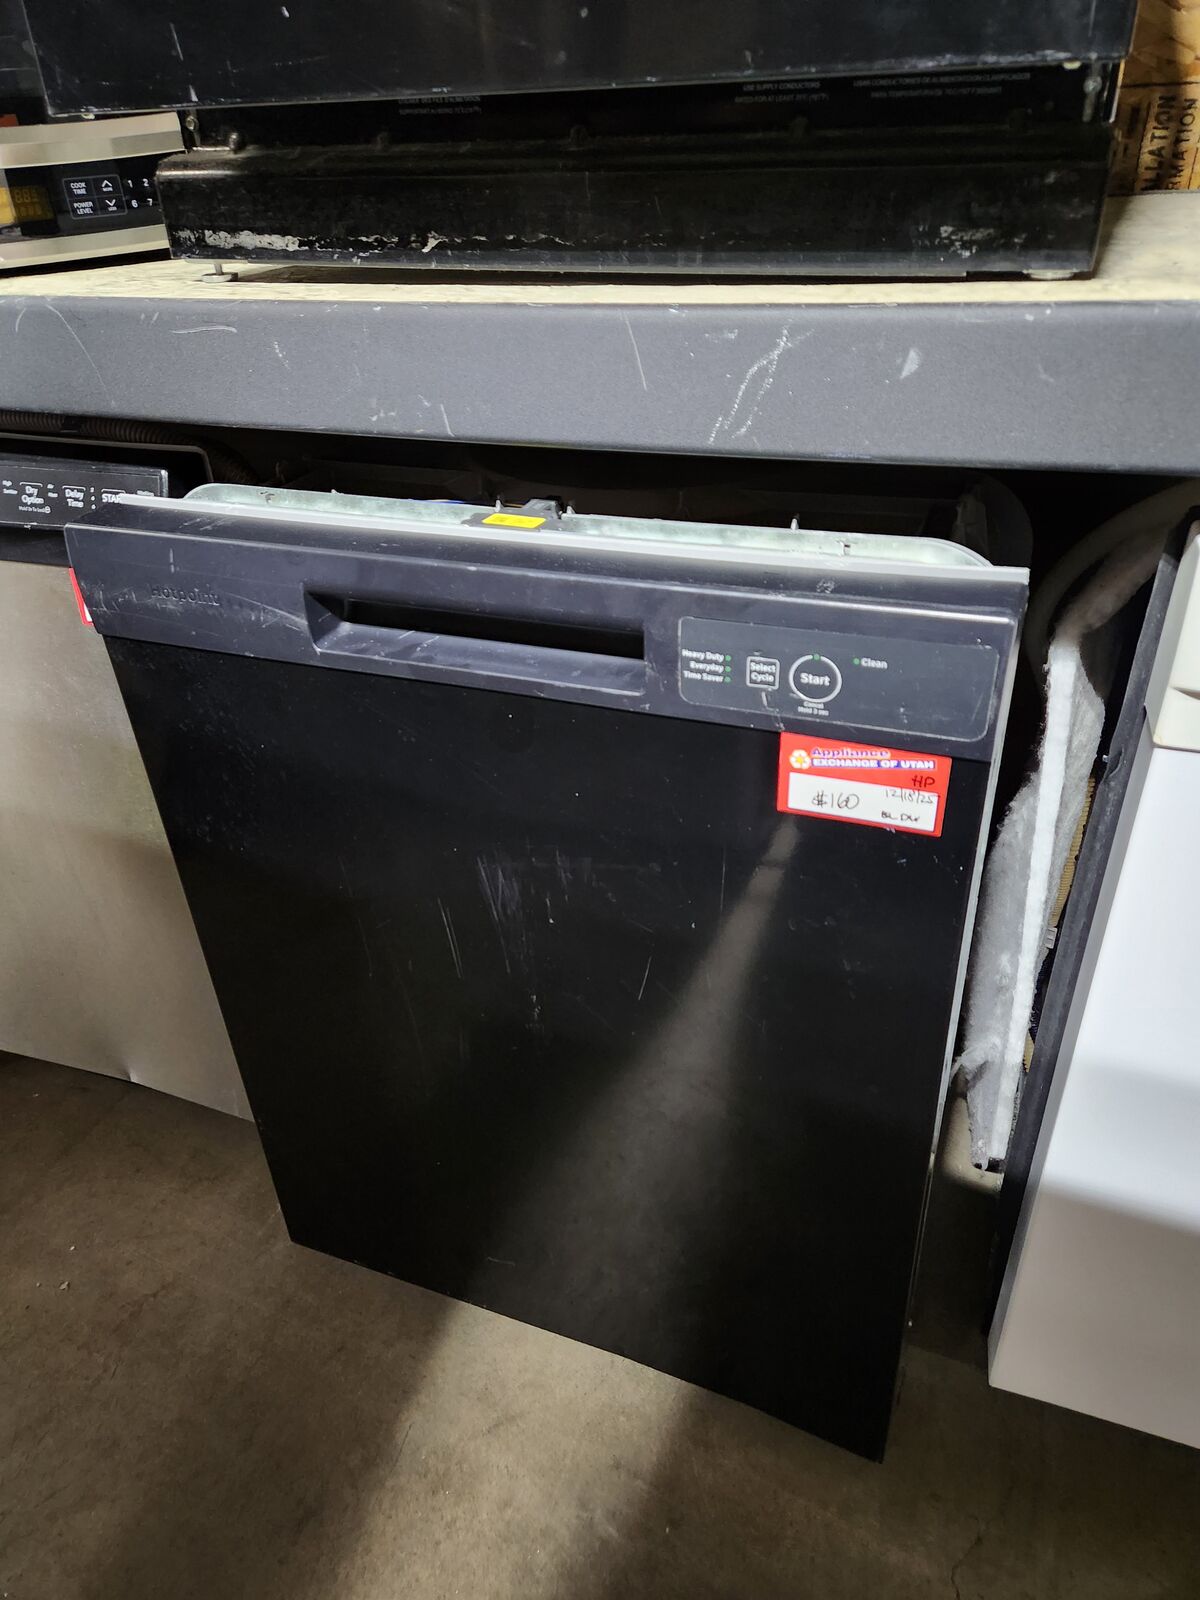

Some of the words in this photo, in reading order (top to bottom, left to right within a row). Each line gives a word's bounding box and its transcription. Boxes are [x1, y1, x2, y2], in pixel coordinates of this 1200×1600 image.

[128, 180, 133, 188] 1
[142, 178, 150, 187] 2
[73, 201, 93, 209] POWER
[131, 200, 138, 208] 6
[147, 198, 153, 206] 7
[77, 207, 94, 215] LEVEL
[25, 486, 38, 496] Dry
[65, 489, 85, 501] Delay
[21, 494, 44, 505] Option
[67, 498, 84, 508] Time
[681, 648, 705, 661] Heavy
[705, 651, 725, 663] Duty
[689, 660, 724, 674] Everyday
[750, 662, 776, 673] Select
[861, 657, 888, 669] Clean
[683, 670, 702, 680] Time
[702, 672, 724, 683] Saver
[751, 672, 774, 683] Cycle
[800, 672, 831, 687] Start
[811, 747, 891, 759] Appliance
[812, 758, 878, 768] EXCHANGE
[881, 760, 897, 768] OF
[900, 761, 935, 769] UTAH
[911, 774, 936, 788] HP
